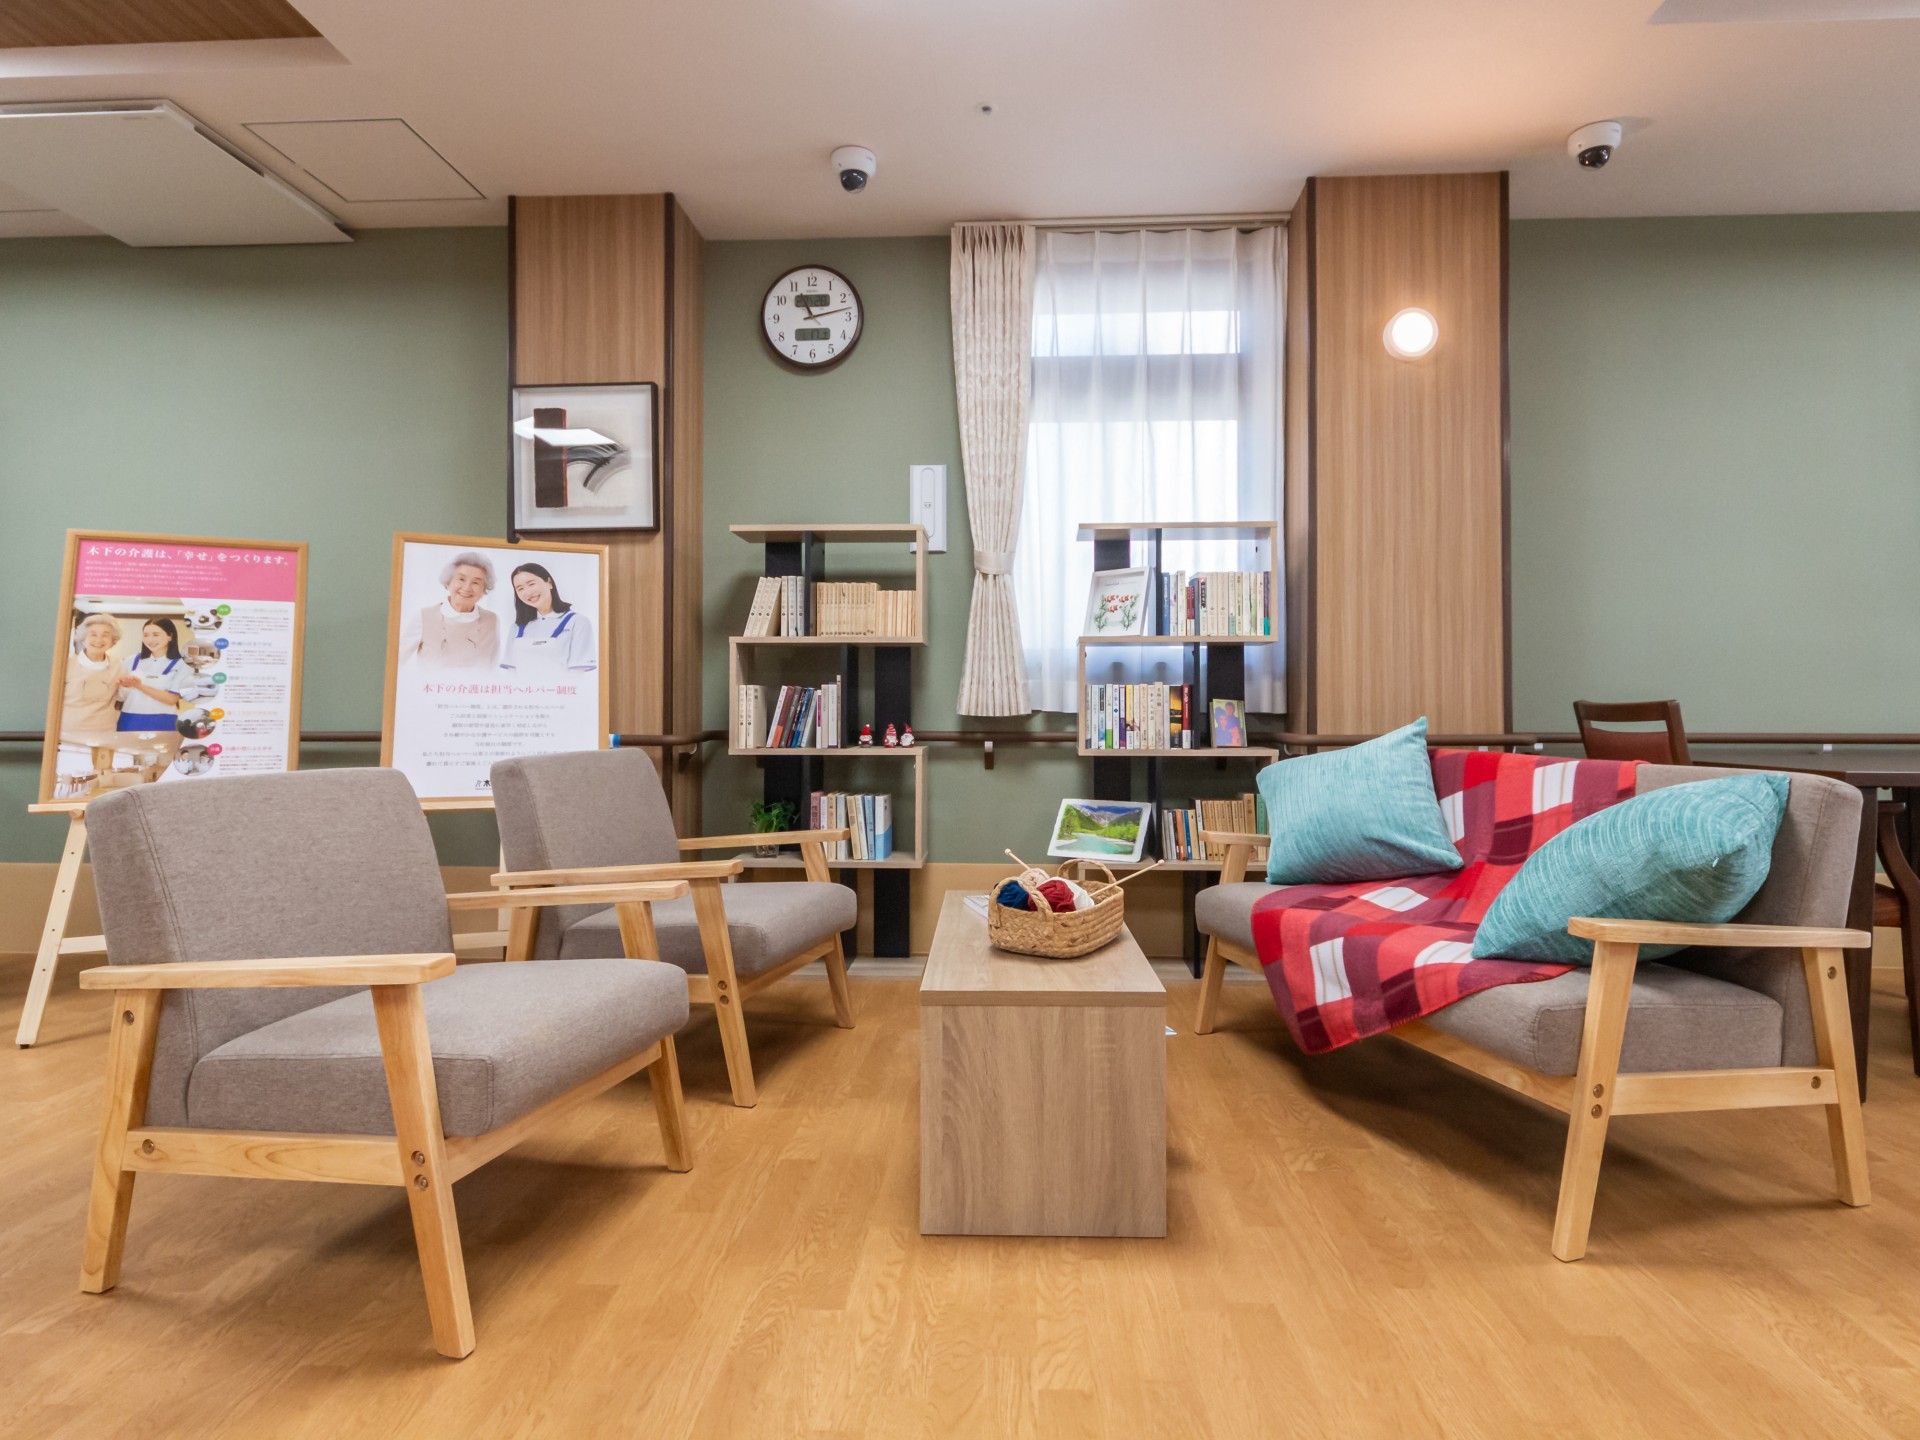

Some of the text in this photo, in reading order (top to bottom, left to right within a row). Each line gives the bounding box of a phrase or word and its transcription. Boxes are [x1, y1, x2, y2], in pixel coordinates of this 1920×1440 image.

[790, 281, 798, 292] 11
[807, 276, 817, 287] 12
[776, 295, 786, 306] 10
[839, 292, 847, 304] 2
[773, 314, 780, 324] 9
[845, 312, 852, 322] 3
[778, 331, 785, 342] 8
[840, 329, 846, 340] 4
[792, 344, 798, 355] 7
[809, 349, 816, 359] 6
[827, 344, 834, 354] 5
[87, 545, 289, 567] 木下の介護は、「幸せ」をつくります。
[423, 683, 577, 696] 木下の介護は担当ヘルパー制度
